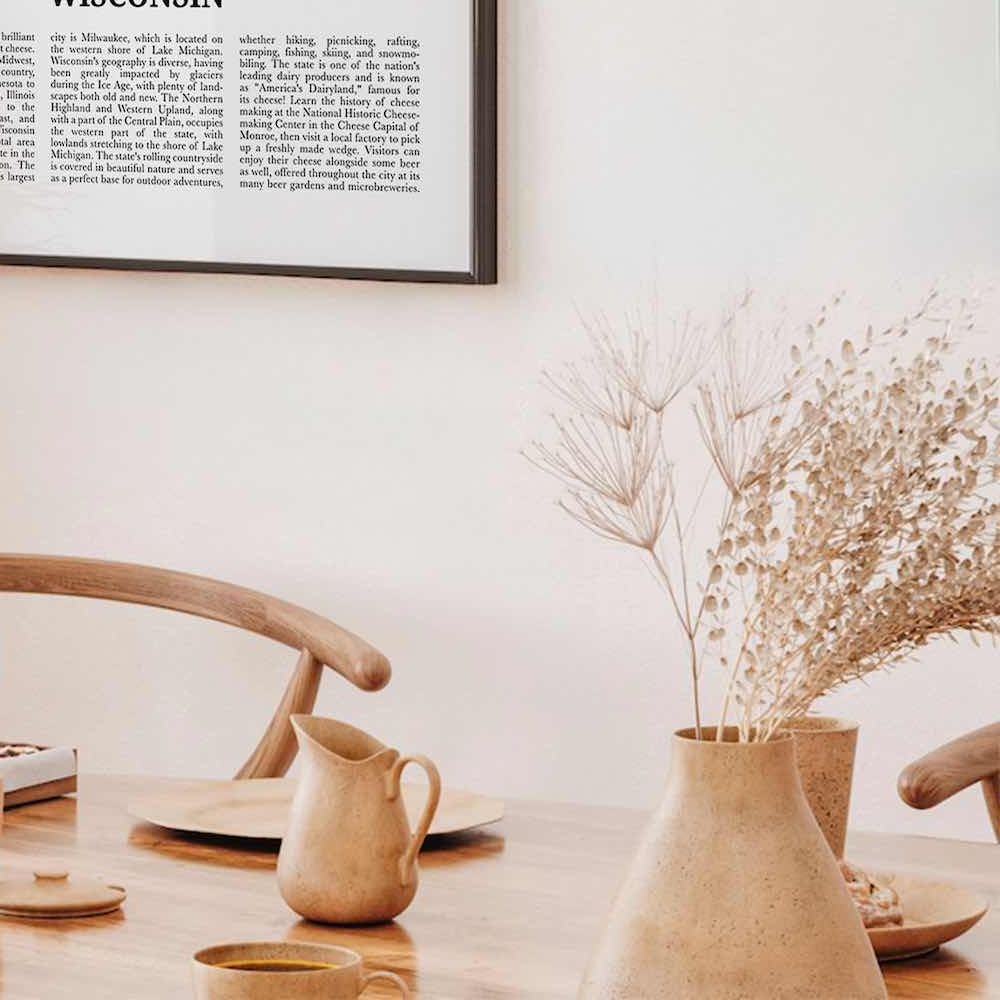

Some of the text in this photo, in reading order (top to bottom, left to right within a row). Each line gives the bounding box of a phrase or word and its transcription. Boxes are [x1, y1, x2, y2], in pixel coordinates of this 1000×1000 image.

[1, 31, 35, 41] brilliant
[50, 33, 66, 45] city
[70, 33, 77, 42] is
[134, 33, 160, 43] which
[164, 34, 172, 43] is
[176, 34, 207, 43] located
[239, 35, 276, 44] whether
[50, 44, 65, 54] the
[67, 45, 102, 54] western
[107, 45, 131, 54] shore
[136, 45, 146, 54] of
[152, 45, 174, 55] Lake
[356, 48, 374, 57] and
[101, 57, 147, 69] geography
[149, 57, 156, 66] is
[194, 57, 224, 70] having
[240, 70, 420, 84] leading dairy producers and is known
[50, 79, 79, 92] during
[81, 80, 95, 89] the
[98, 80, 111, 89] Ice
[136, 80, 155, 90] with
[157, 81, 185, 93] plenty
[187, 81, 198, 90] of
[368, 84, 401, 94] famous
[406, 85, 421, 94] for
[7, 90, 35, 99] Illinois
[51, 103, 92, 115] Highland
[96, 103, 113, 113] and
[117, 104, 153, 113] Western
[199, 105, 224, 117] along
[239, 106, 273, 119] making
[274, 108, 285, 116] at
[286, 107, 300, 117] the
[303, 107, 342, 117] National
[343, 108, 382, 118] Historic
[51, 126, 64, 135] the
[71, 127, 104, 136] western
[111, 128, 129, 139] part
[136, 127, 146, 137] of
[153, 128, 167, 137] the
[204, 129, 223, 138] with
[280, 131, 300, 141] then
[302, 131, 321, 141] visit
[331, 132, 352, 142] local
[355, 132, 387, 145] factory
[389, 134, 399, 142] to
[401, 133, 420, 145] pick
[96, 150, 114, 160] The
[143, 151, 171, 164] rolling
[172, 152, 223, 165] countryside
[18, 160, 35, 169] The
[6, 171, 35, 184] largest
[69, 173, 99, 186] perfect
[101, 174, 120, 183] base
[122, 174, 135, 184] for
[136, 174, 171, 185] outdoor
[274, 167, 306, 177] offered
[309, 168, 359, 181] throughout
[362, 169, 376, 178] the
[378, 169, 396, 181] city
[398, 170, 407, 179] at
[410, 170, 420, 179] its
[240, 181, 265, 191] many
[267, 179, 287, 189] beer
[289, 179, 325, 192] gardens
[327, 180, 345, 190] and
